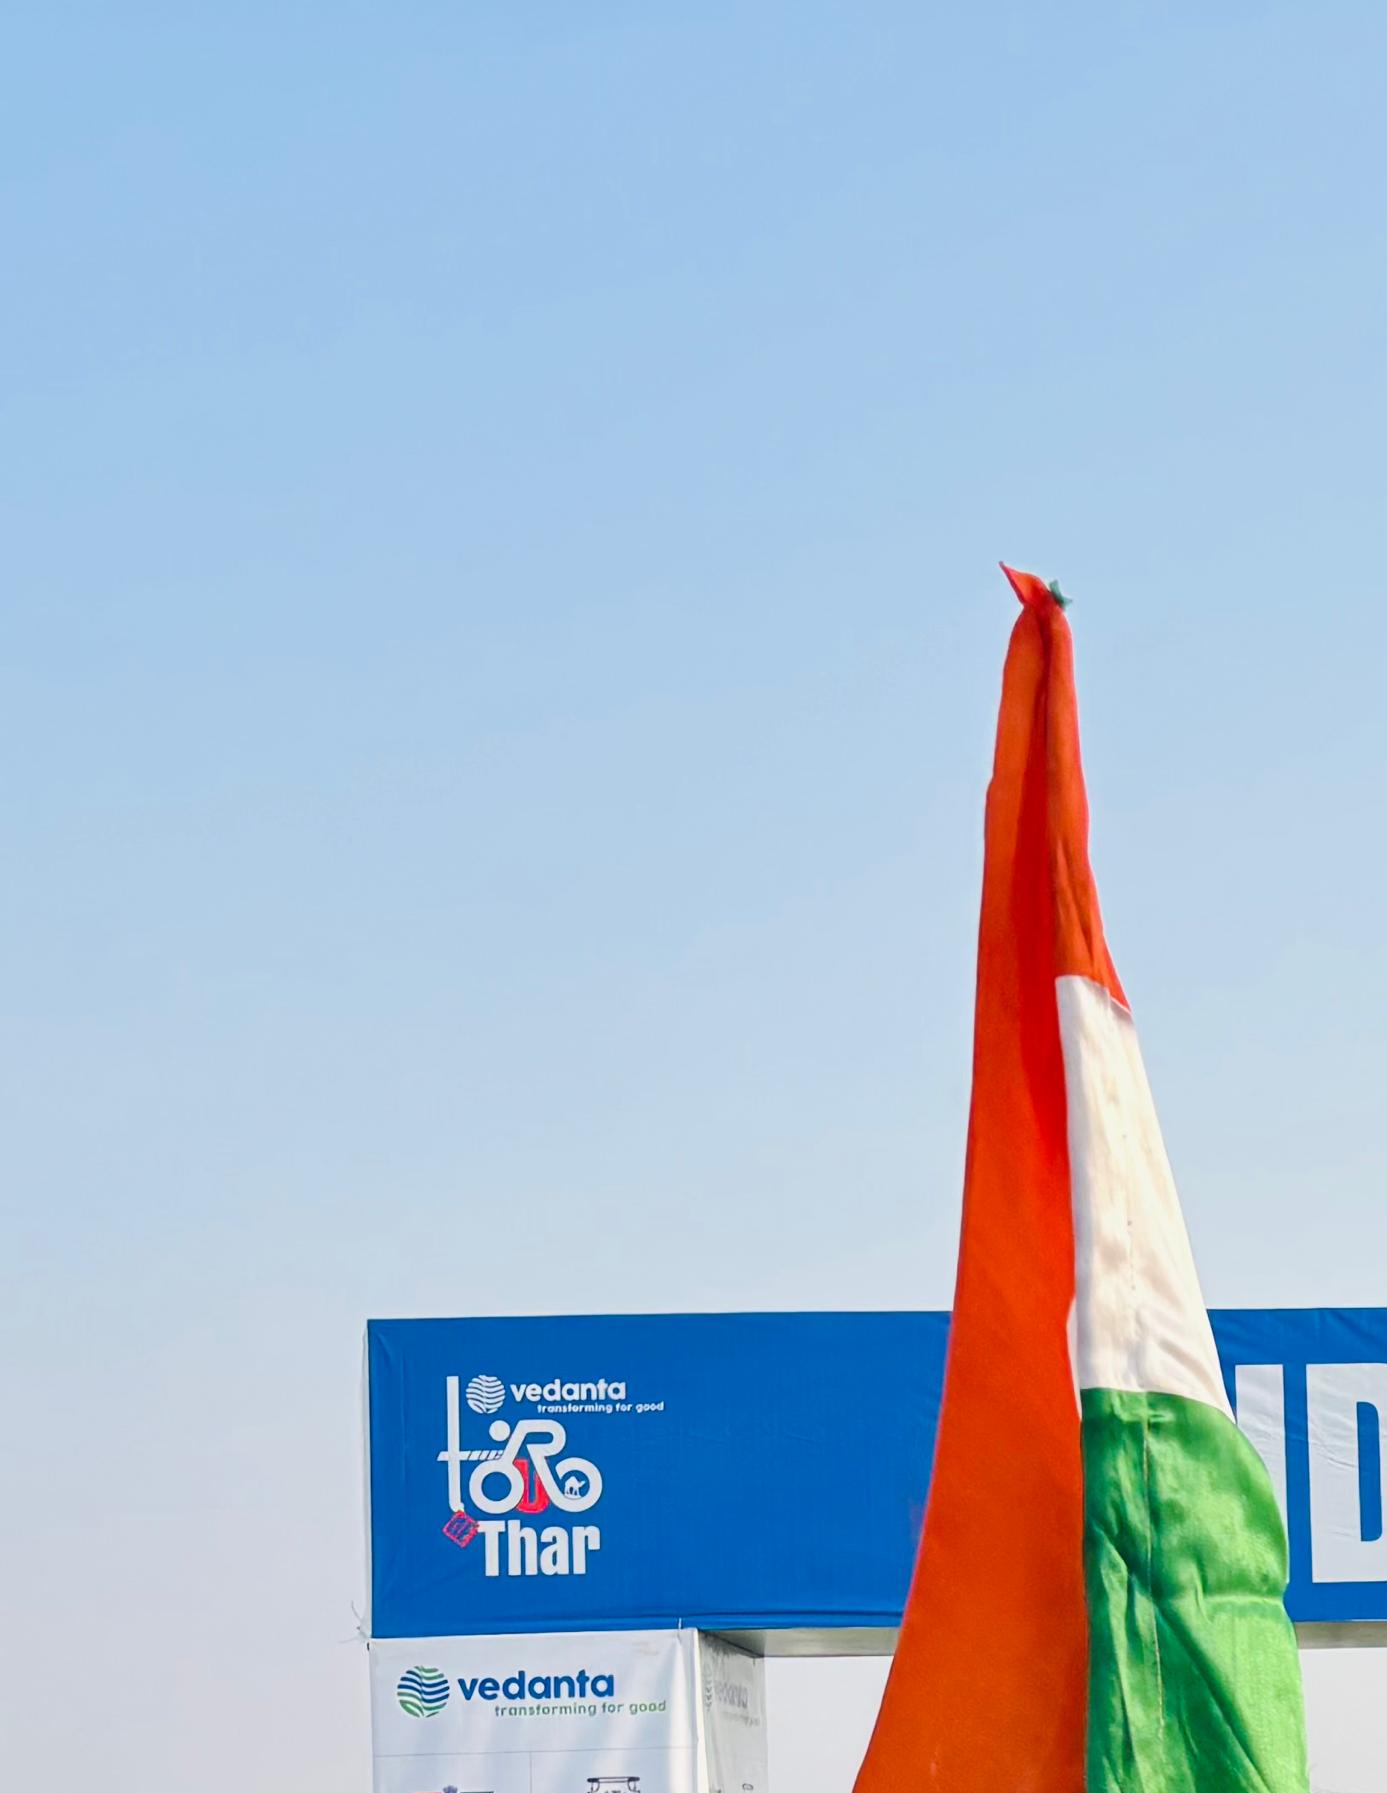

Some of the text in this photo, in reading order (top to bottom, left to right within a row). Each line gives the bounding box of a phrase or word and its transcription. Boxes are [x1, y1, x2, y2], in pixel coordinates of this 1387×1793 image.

[511, 1378, 626, 1402] vedanta
[537, 1401, 664, 1414] transforming for good
[478, 1520, 600, 1577] Thar
[458, 1669, 615, 1701] vedanta
[495, 1700, 666, 1718] transforming for good
